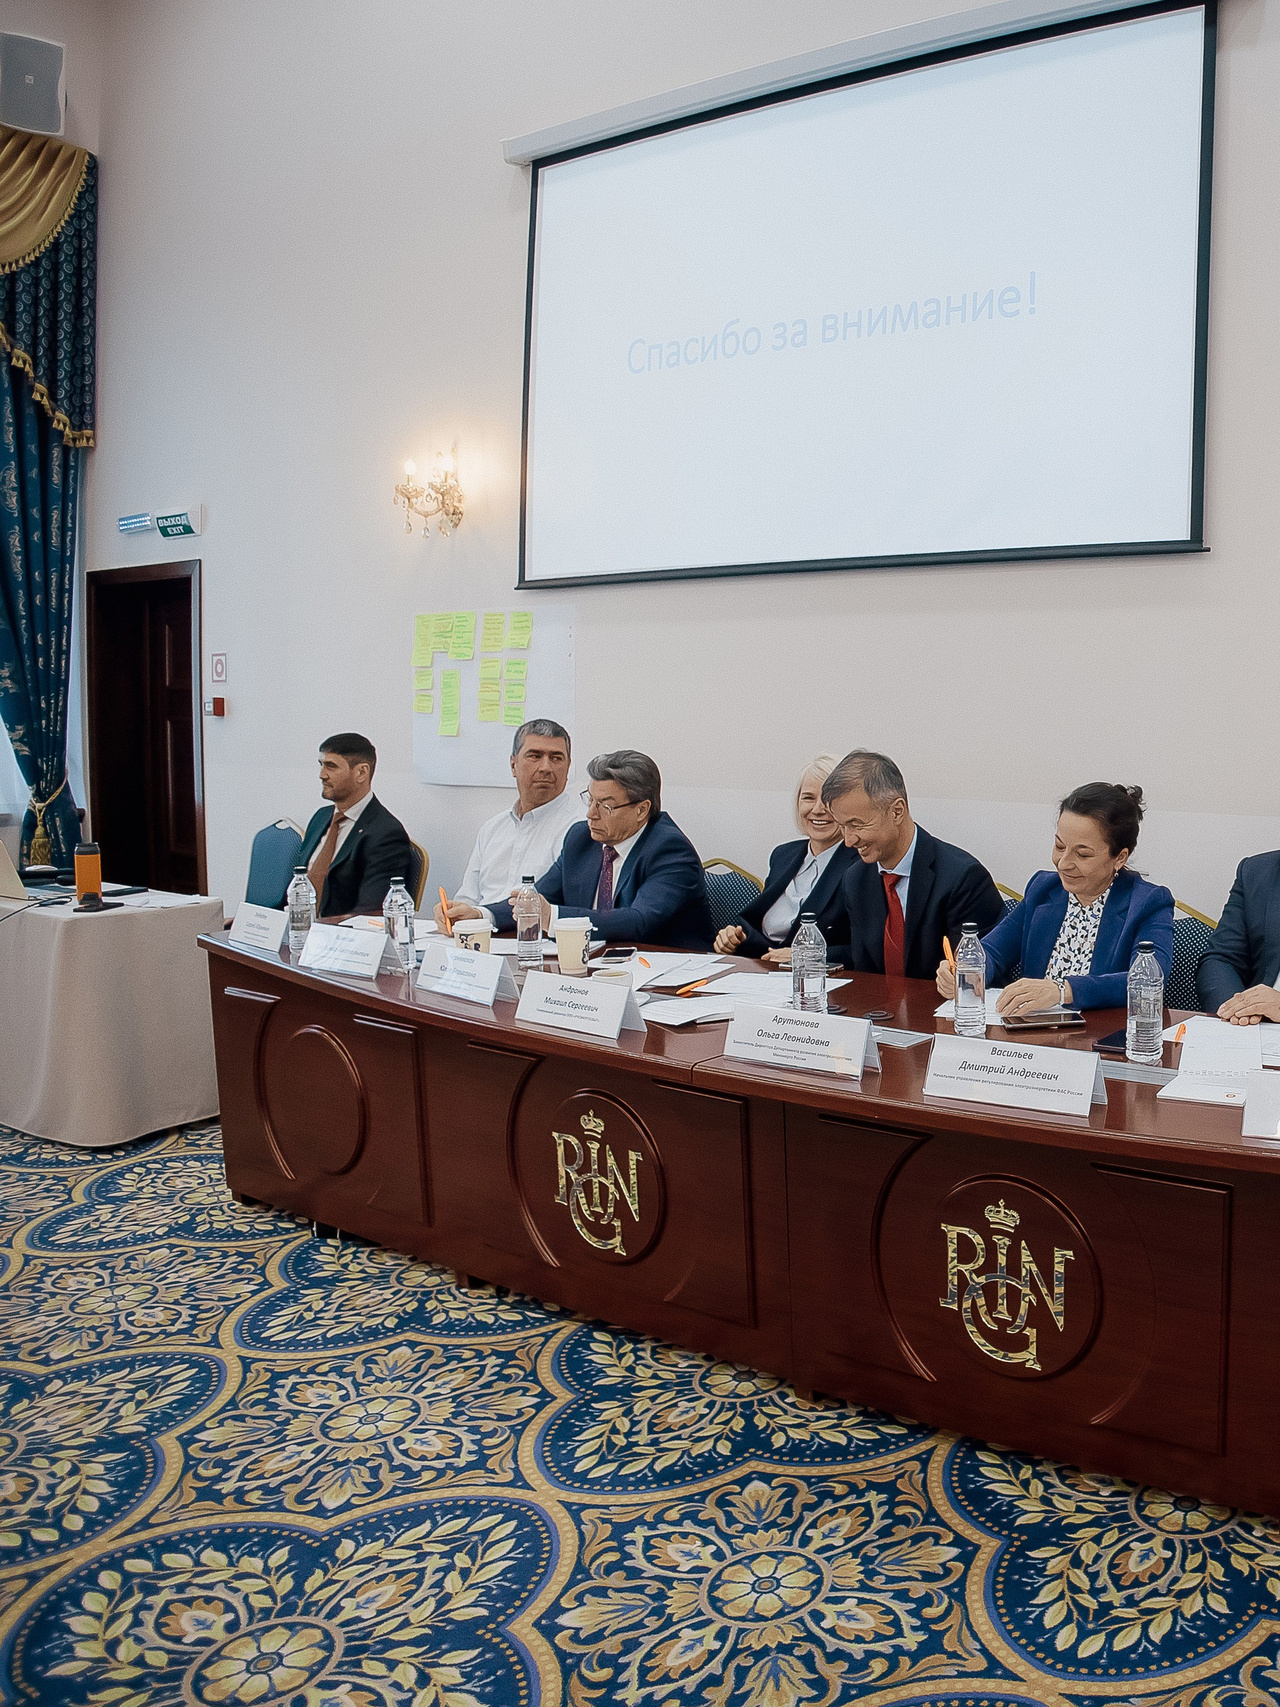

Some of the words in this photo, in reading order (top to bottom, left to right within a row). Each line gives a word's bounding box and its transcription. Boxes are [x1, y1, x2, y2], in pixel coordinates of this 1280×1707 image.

[626, 318, 762, 374] Спасибо
[771, 318, 808, 351] за
[820, 271, 1037, 345] внимание!
[158, 515, 189, 527] ВЫХОД
[167, 526, 184, 535] EXIT
[559, 985, 589, 996] Андронов
[544, 997, 567, 1007] Михаил
[567, 1001, 599, 1012] Сергеевич
[772, 1014, 820, 1029] Арутюнова
[757, 1029, 780, 1040] Ольга
[780, 1033, 830, 1047] Леонидовна
[990, 1046, 1034, 1060] Васильев
[958, 1060, 1006, 1074] Дмитрий
[1006, 1066, 1059, 1082] Андреевич
